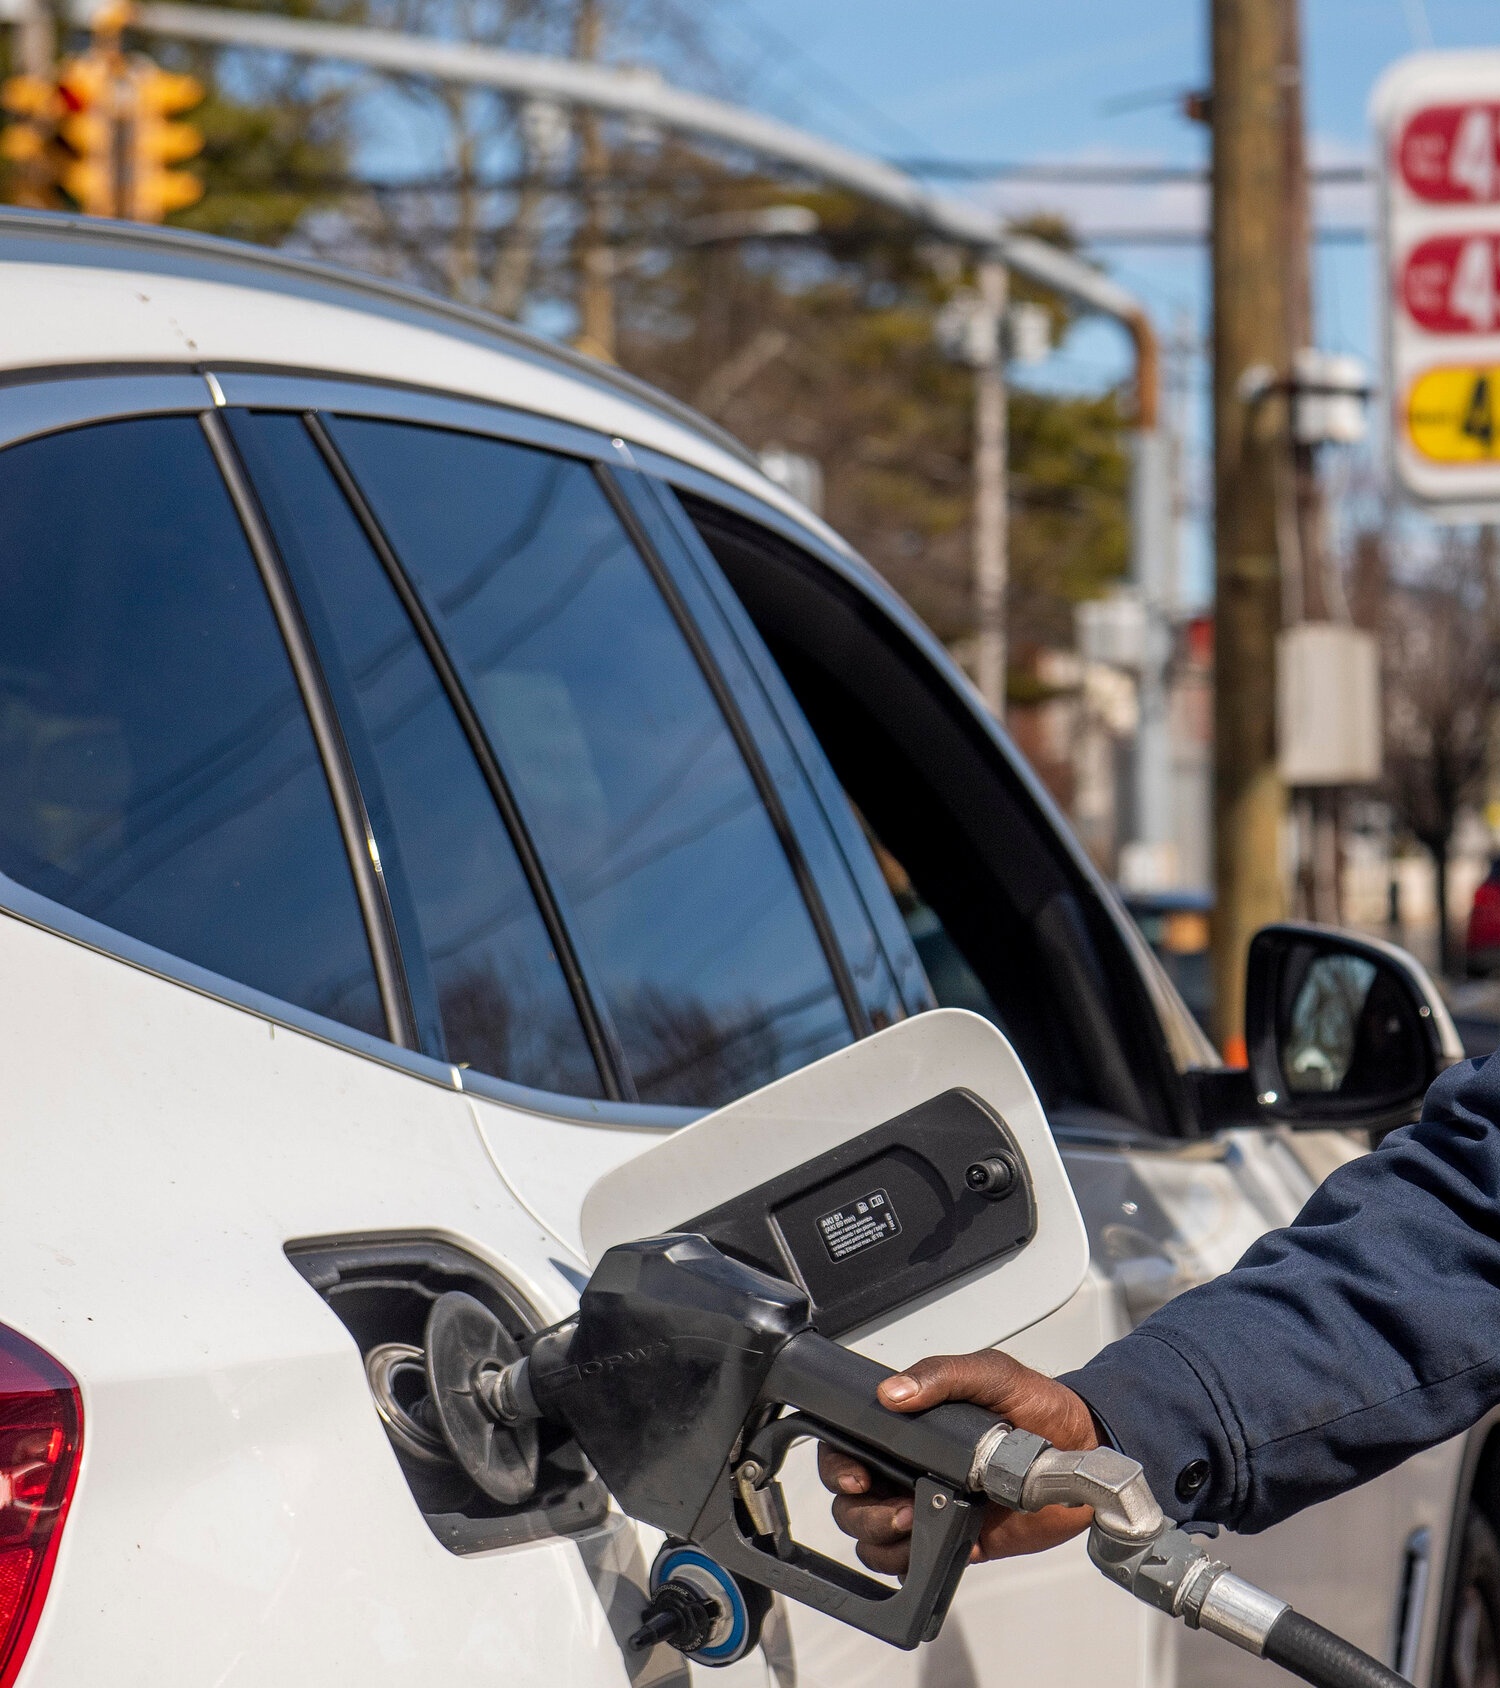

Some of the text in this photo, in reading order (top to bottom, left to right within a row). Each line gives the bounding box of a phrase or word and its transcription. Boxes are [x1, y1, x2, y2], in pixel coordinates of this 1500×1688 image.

[821, 1212, 843, 1227] AKI 91
[825, 1224, 836, 1234] (AKI
[843, 1215, 856, 1224] min)
